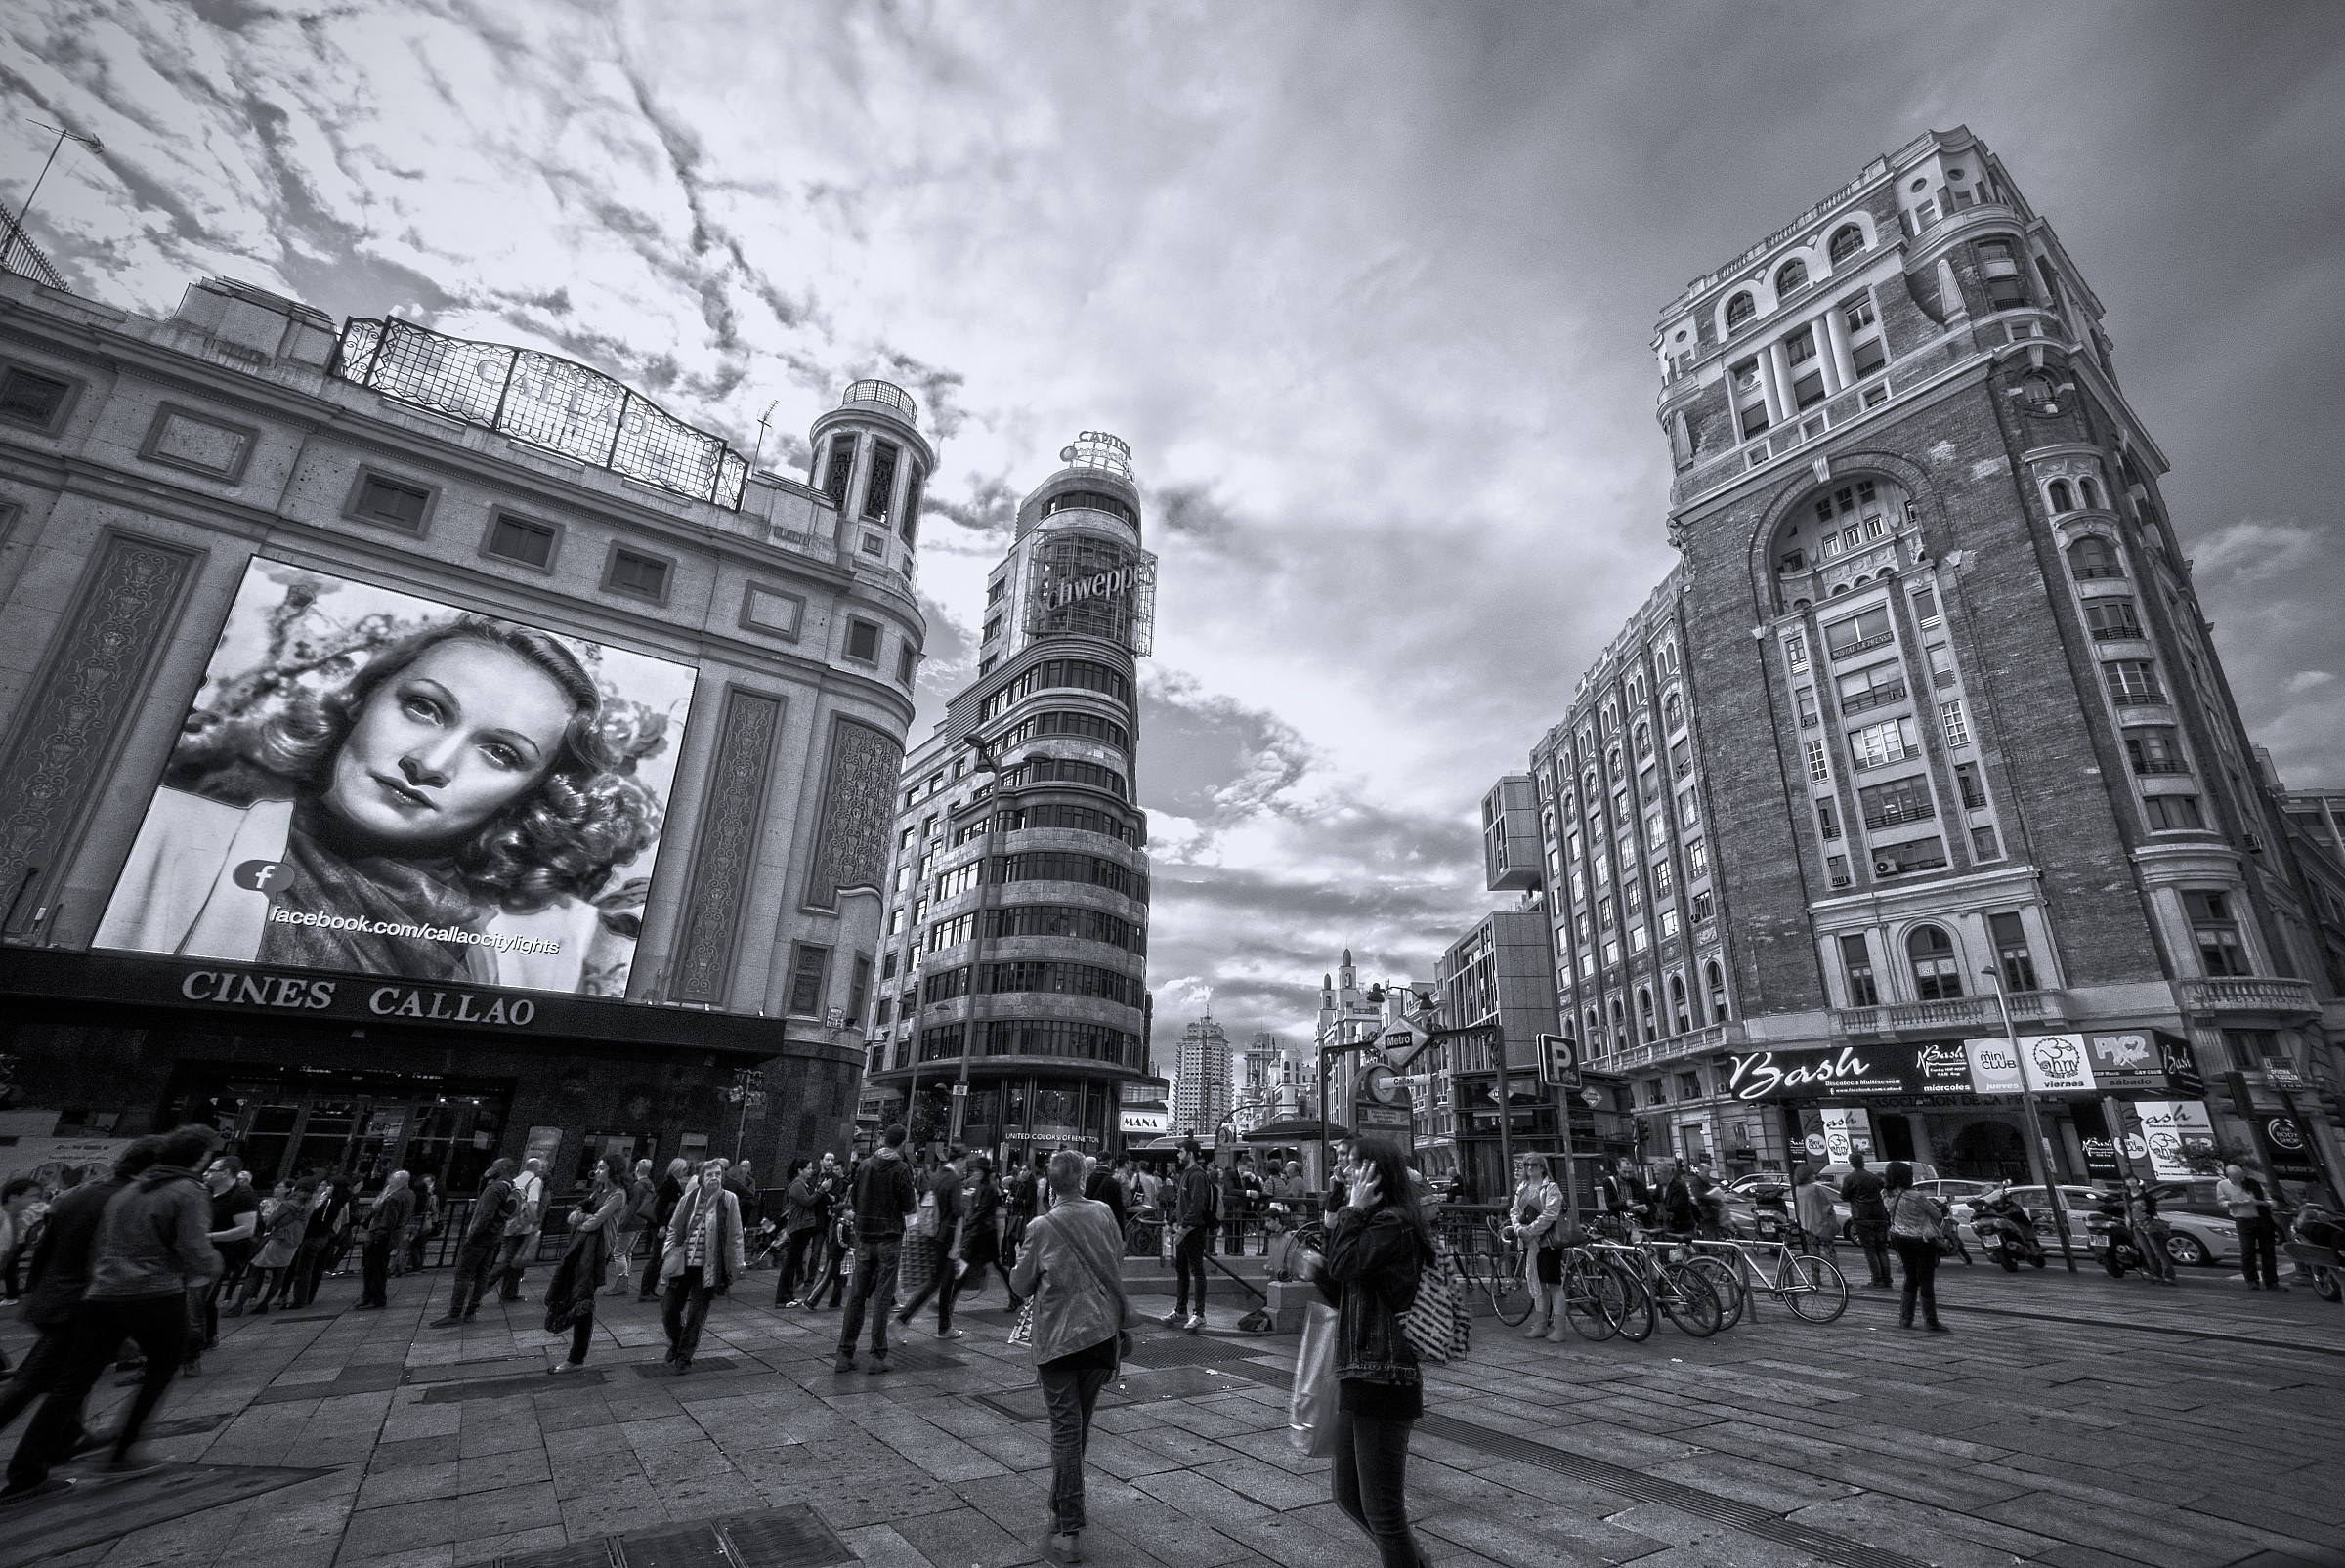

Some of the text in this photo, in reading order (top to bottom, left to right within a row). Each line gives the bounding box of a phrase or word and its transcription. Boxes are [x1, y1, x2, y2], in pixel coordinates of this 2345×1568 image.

[525, 351, 619, 400] CINES
[477, 360, 649, 436] CALLAO
[1079, 431, 1132, 460] CAPITOL
[270, 906, 560, 955] facebook.com/callaocitylights
[182, 971, 534, 1025] CINES CALLAO
[1387, 1036, 1411, 1047] Metro
[1981, 1051, 2006, 1061] mini
[1551, 1041, 1572, 1081] P
[1730, 1047, 1870, 1100] Bash
[1982, 1060, 2017, 1070] CLUB
[2160, 1045, 2192, 1075] Bash
[2110, 1078, 2152, 1086] sábado
[1124, 1117, 1158, 1127] MANA
